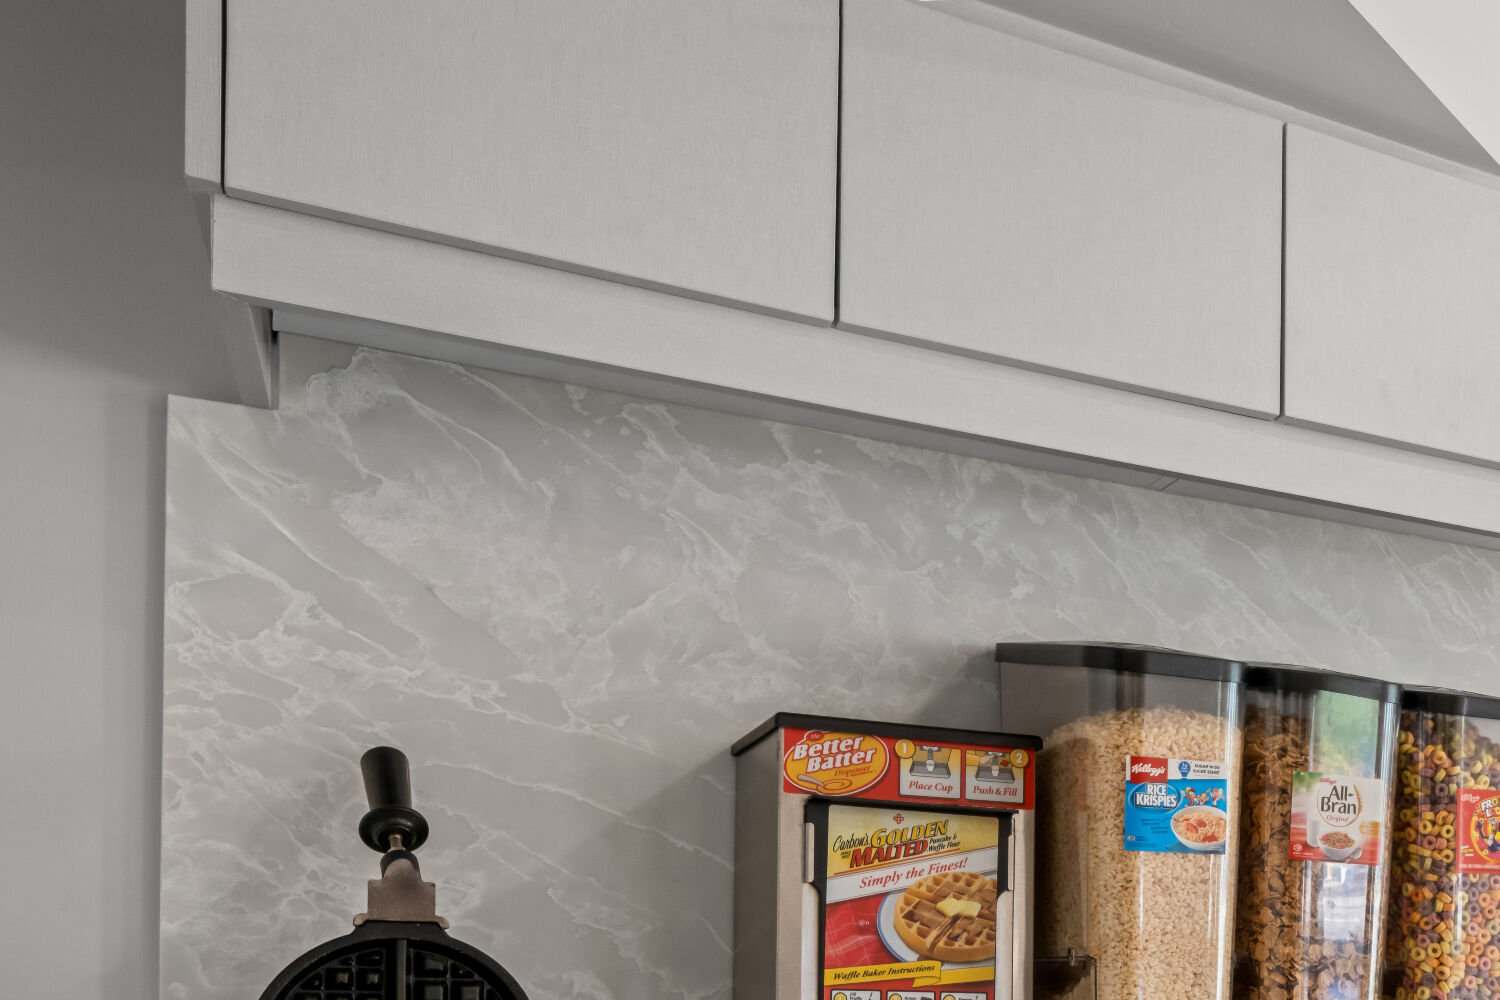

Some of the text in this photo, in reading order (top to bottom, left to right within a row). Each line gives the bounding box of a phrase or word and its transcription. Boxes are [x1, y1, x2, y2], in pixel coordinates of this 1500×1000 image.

[793, 736, 864, 760] Better
[902, 742, 907, 754] 1
[807, 749, 876, 772] Batter
[1017, 752, 1023, 763] 2
[834, 765, 871, 777] Dispenser
[1131, 762, 1166, 777] Kellogg's
[909, 780, 953, 794] Place Cup
[973, 785, 994, 795] Push
[1003, 787, 1018, 796] Fill
[1147, 783, 1167, 796] RICE
[1328, 785, 1354, 801] All-
[1136, 794, 1177, 808] KRISPIES
[1320, 796, 1357, 815] Bran
[833, 820, 949, 852] Carbon's GOLDEN
[849, 839, 929, 869] MALTED
[859, 856, 968, 889] Simply the Finest!
[833, 964, 936, 981] Waffle Baker Instructions
